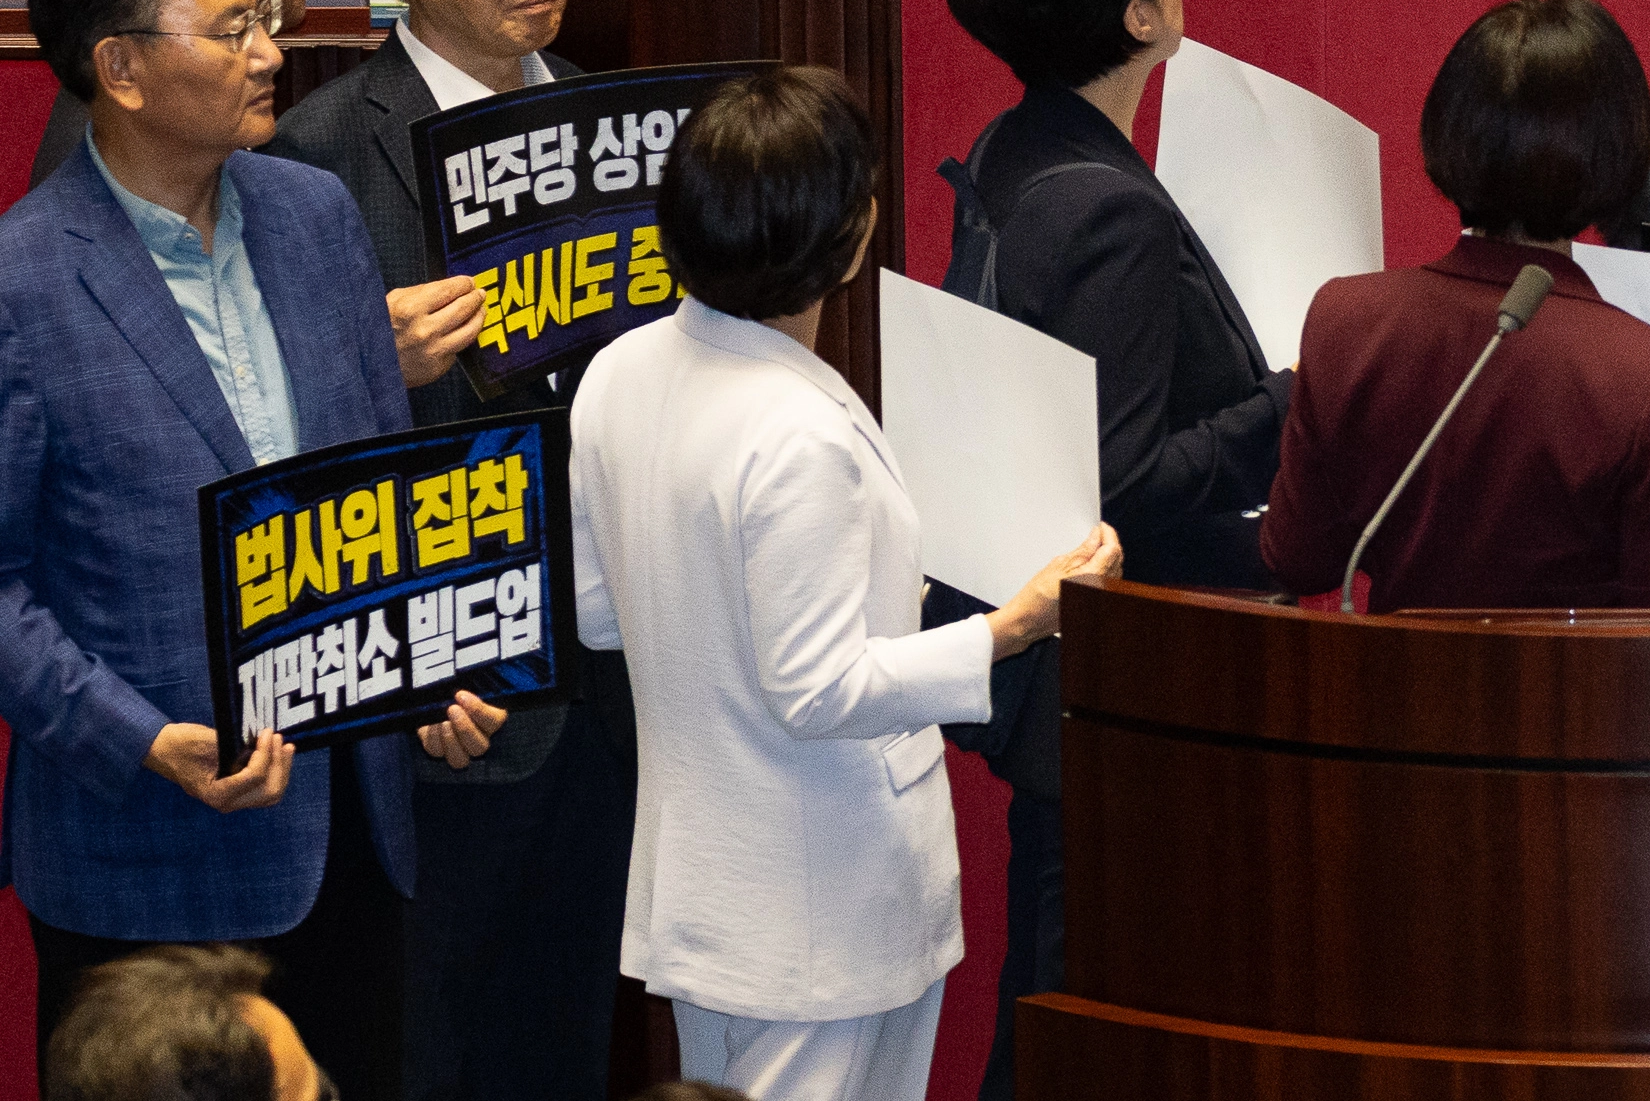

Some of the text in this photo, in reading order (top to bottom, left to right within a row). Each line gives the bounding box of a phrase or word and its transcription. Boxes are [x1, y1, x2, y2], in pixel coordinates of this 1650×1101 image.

[445, 123, 578, 234] 민주당
[472, 232, 617, 354] 독식시도
[235, 453, 529, 630] 법사위 집착
[238, 562, 542, 744] 재판취소 빌드업
